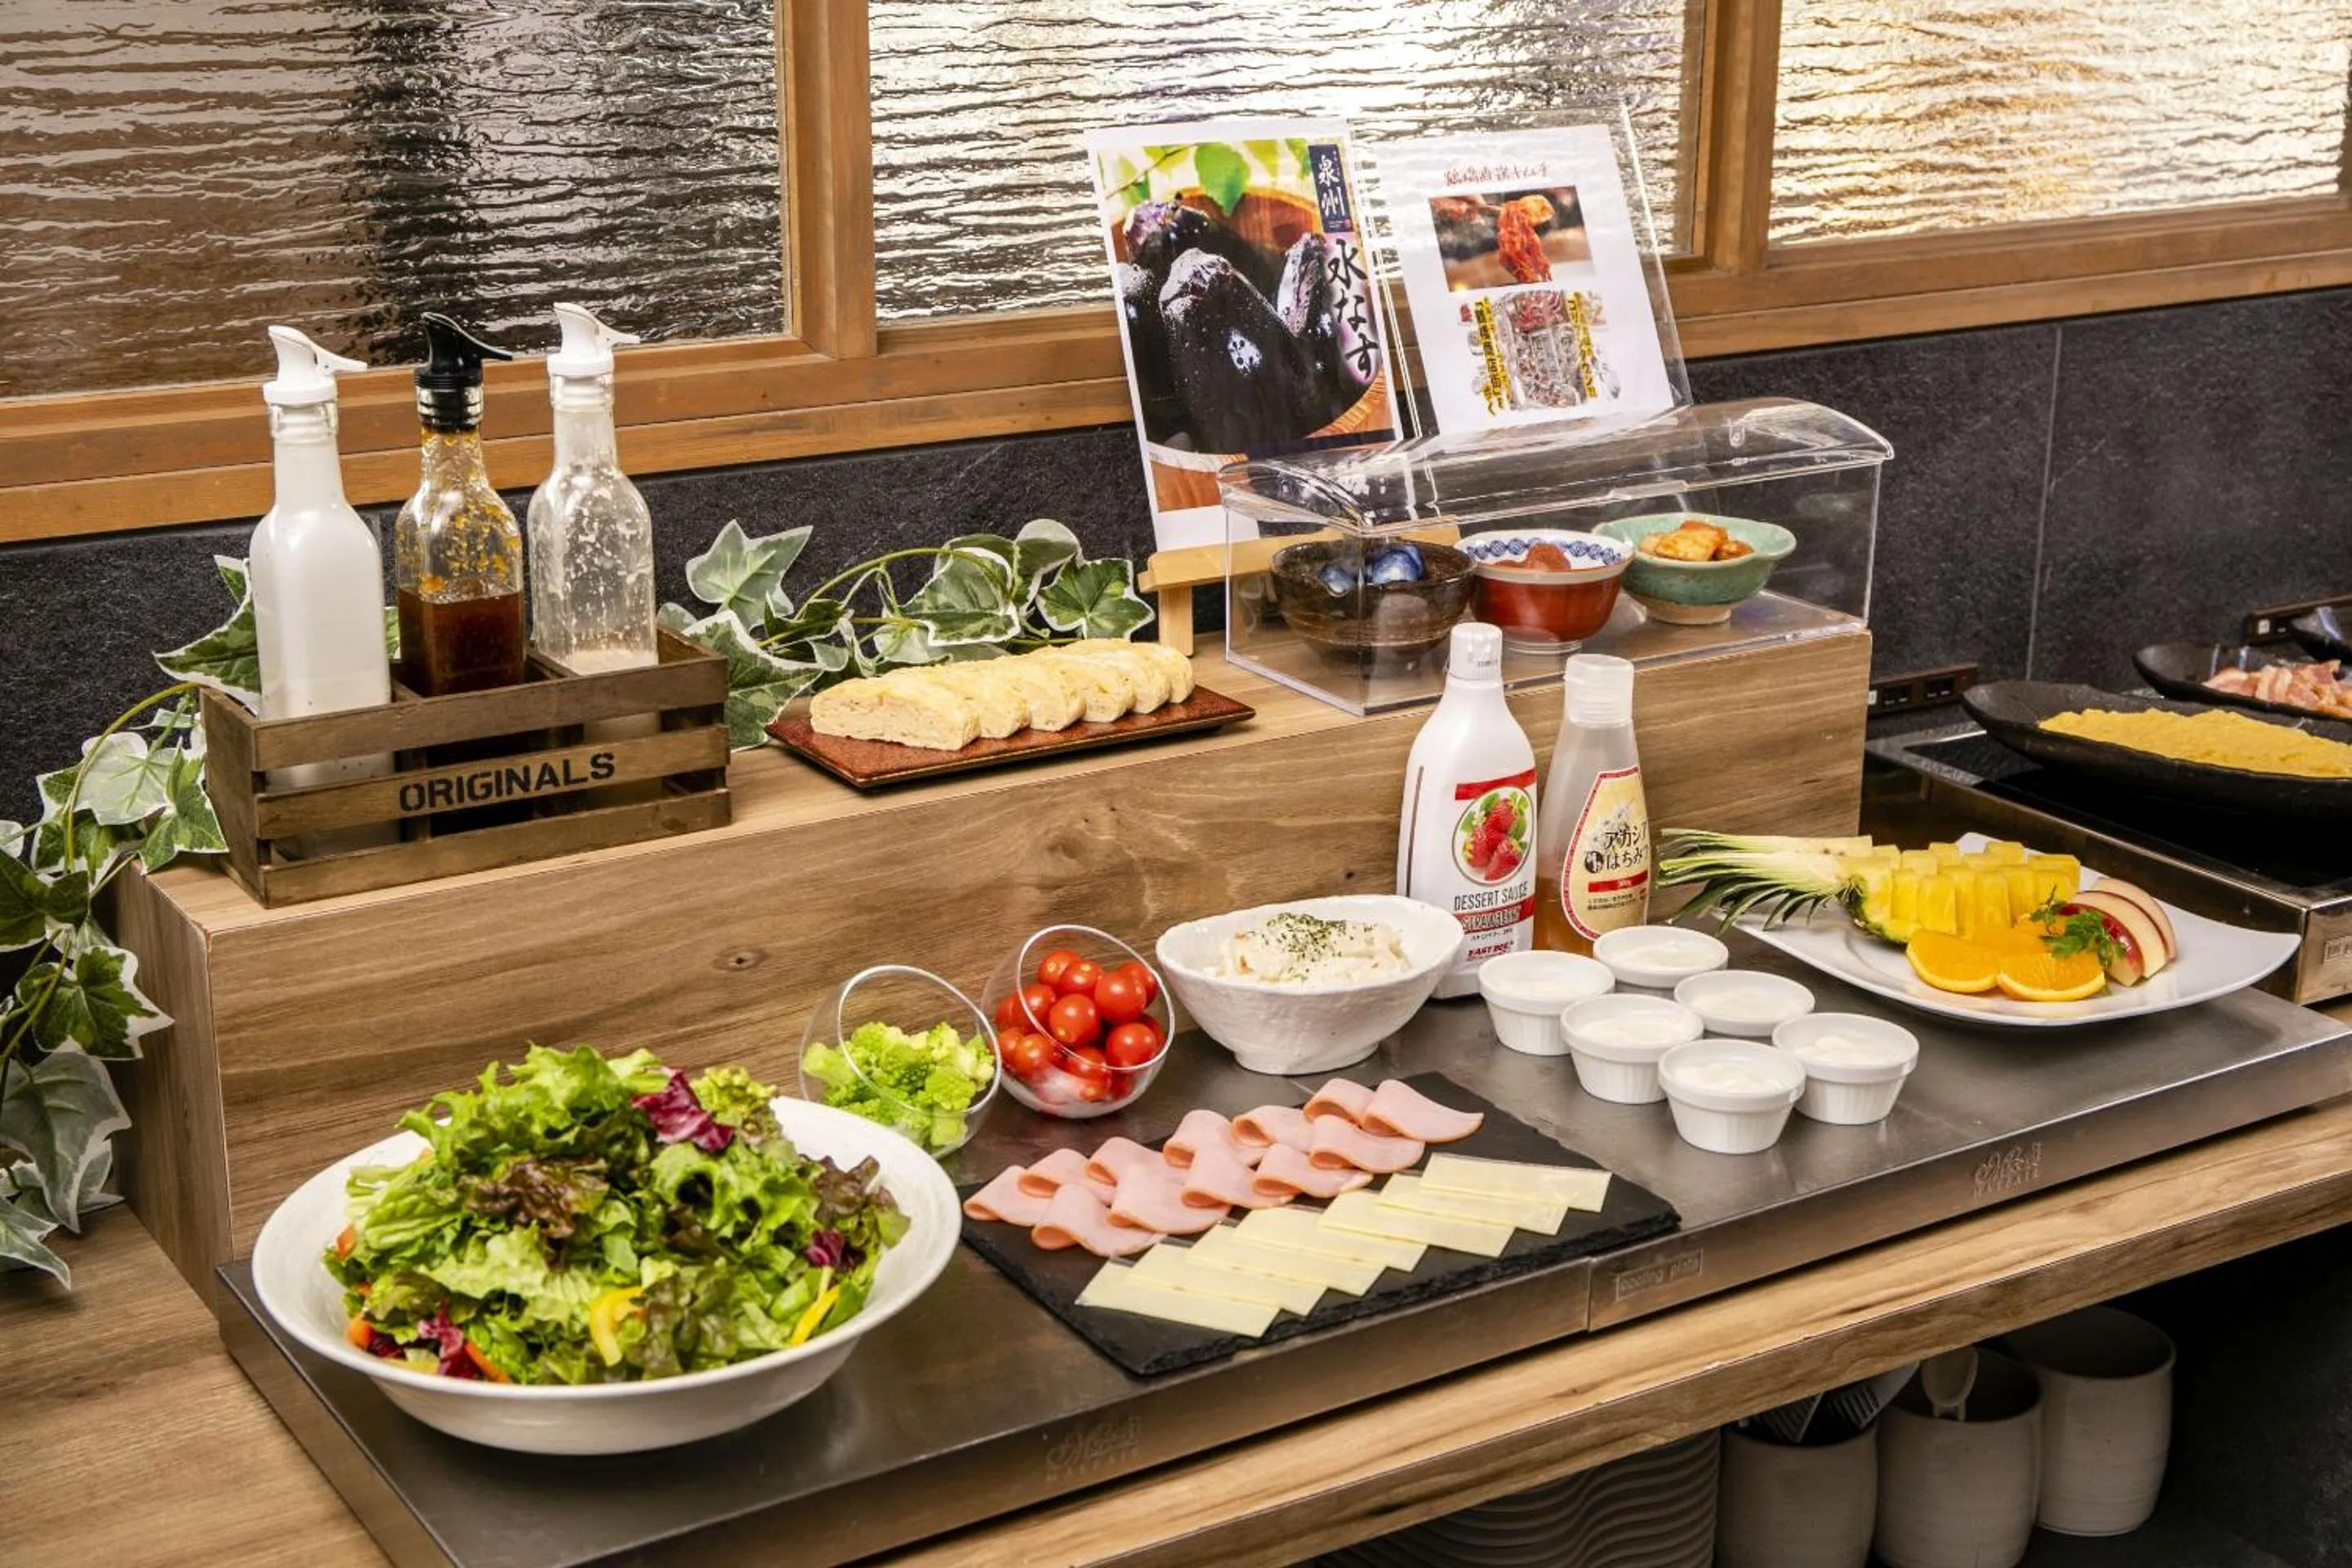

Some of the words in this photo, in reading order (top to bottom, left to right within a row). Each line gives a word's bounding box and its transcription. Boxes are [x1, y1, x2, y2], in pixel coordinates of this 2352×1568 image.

[1318, 154, 1346, 216] 泉州
[1327, 238, 1379, 380] 水なす
[399, 752, 615, 812] ORIGINALS
[1454, 890, 1499, 911] DESSERT
[1502, 880, 1529, 903] SAUCE
